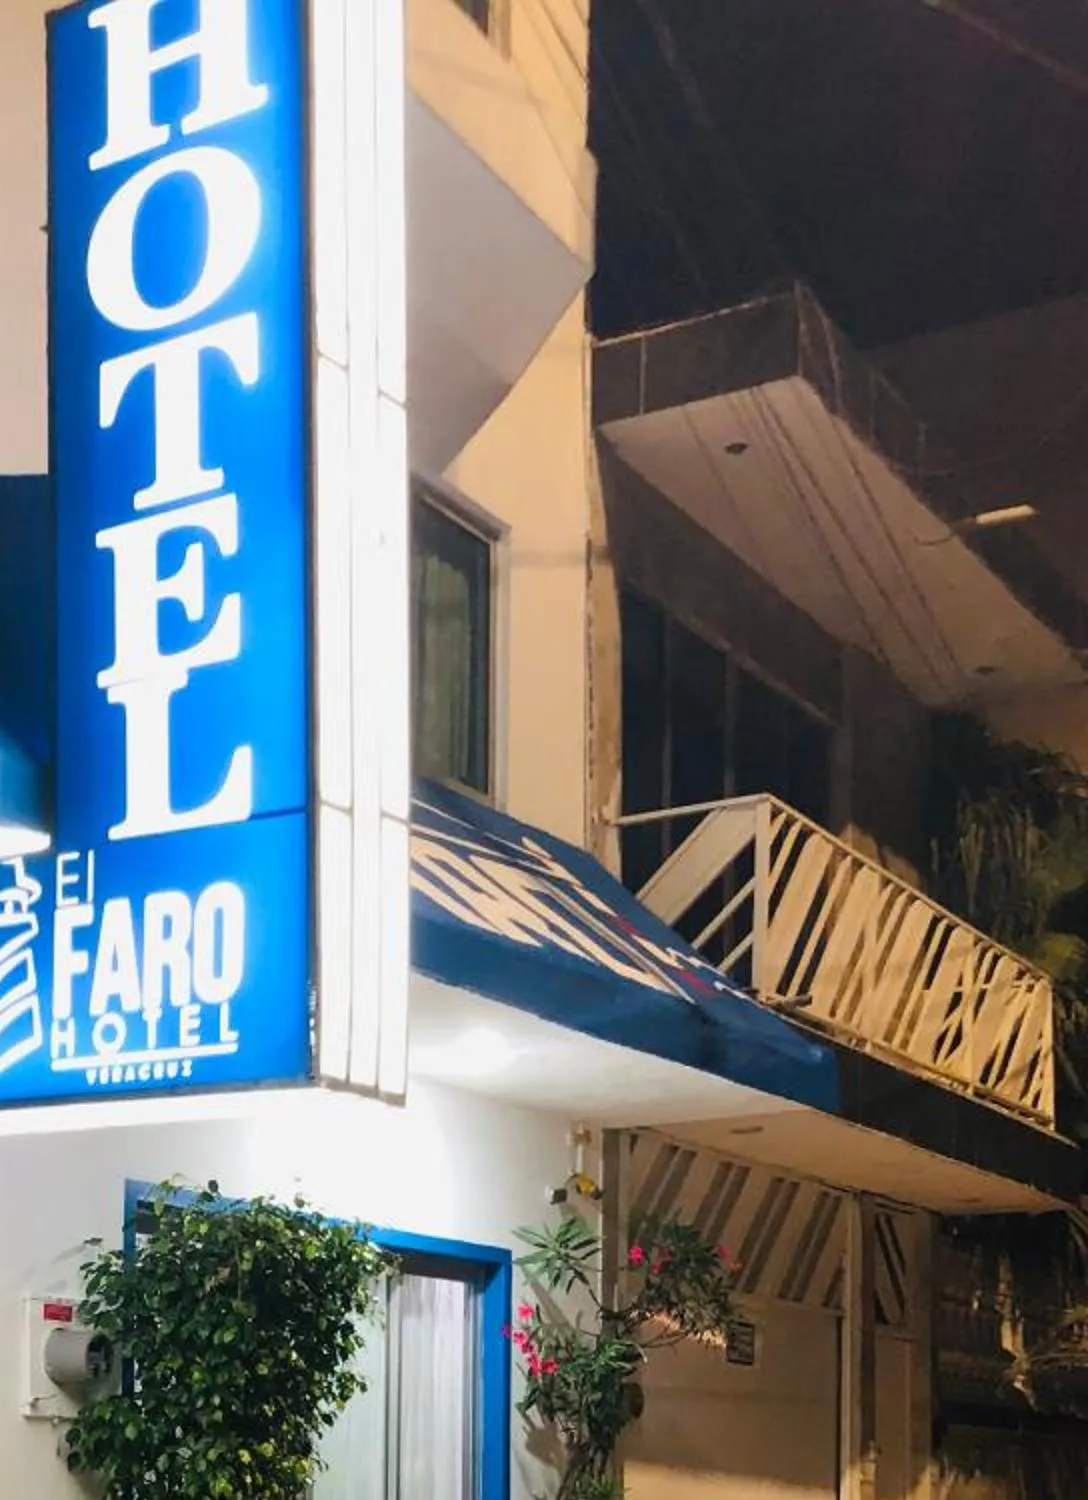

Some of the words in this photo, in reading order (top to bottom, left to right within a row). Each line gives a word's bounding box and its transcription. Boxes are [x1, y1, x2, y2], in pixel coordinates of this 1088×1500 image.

[86, 0, 269, 841] HOTEL
[52, 881, 245, 1020] FARO
[51, 1002, 239, 1059] HOTEL
